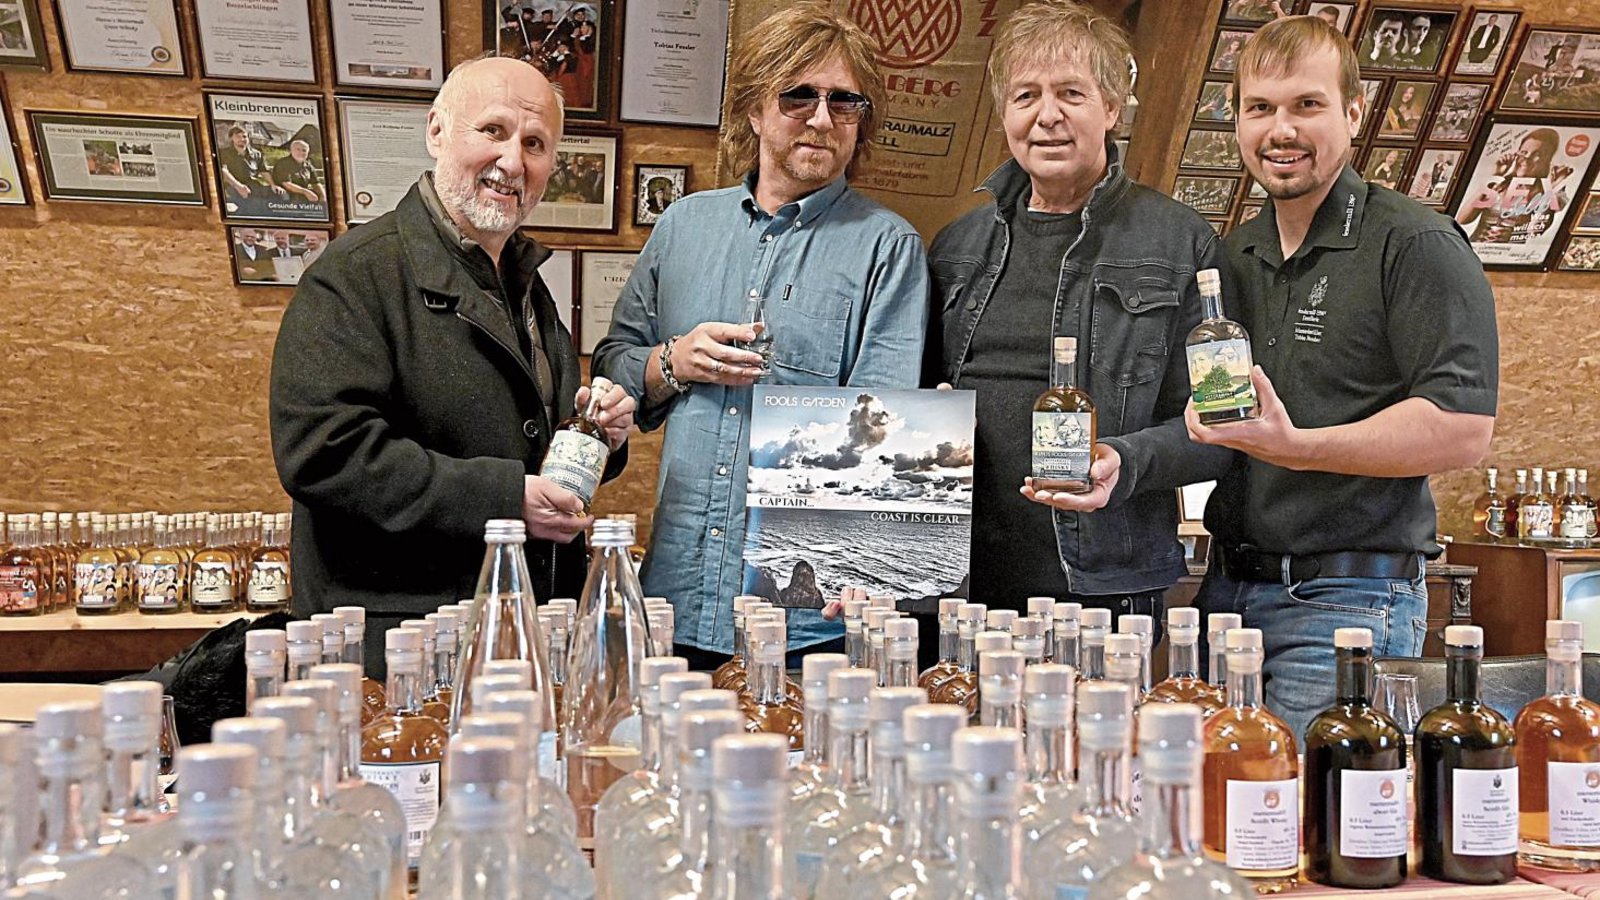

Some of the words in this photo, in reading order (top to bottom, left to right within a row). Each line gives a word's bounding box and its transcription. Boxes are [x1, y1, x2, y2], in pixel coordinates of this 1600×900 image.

[887, 74, 961, 98] BERG
[213, 99, 315, 116] Kleinbrennerei
[888, 95, 940, 109] MANY
[882, 120, 953, 138] RAUMALZ
[875, 136, 900, 148] ELL
[268, 202, 298, 210] Gesunde
[299, 203, 323, 211] Vielfalt
[764, 395, 798, 407] FOOLS
[802, 396, 846, 408] GARDEN
[759, 496, 815, 508] CAPTAIN...
[871, 511, 908, 523] COAST
[911, 513, 921, 523] IS
[923, 514, 960, 524] CLEAR
